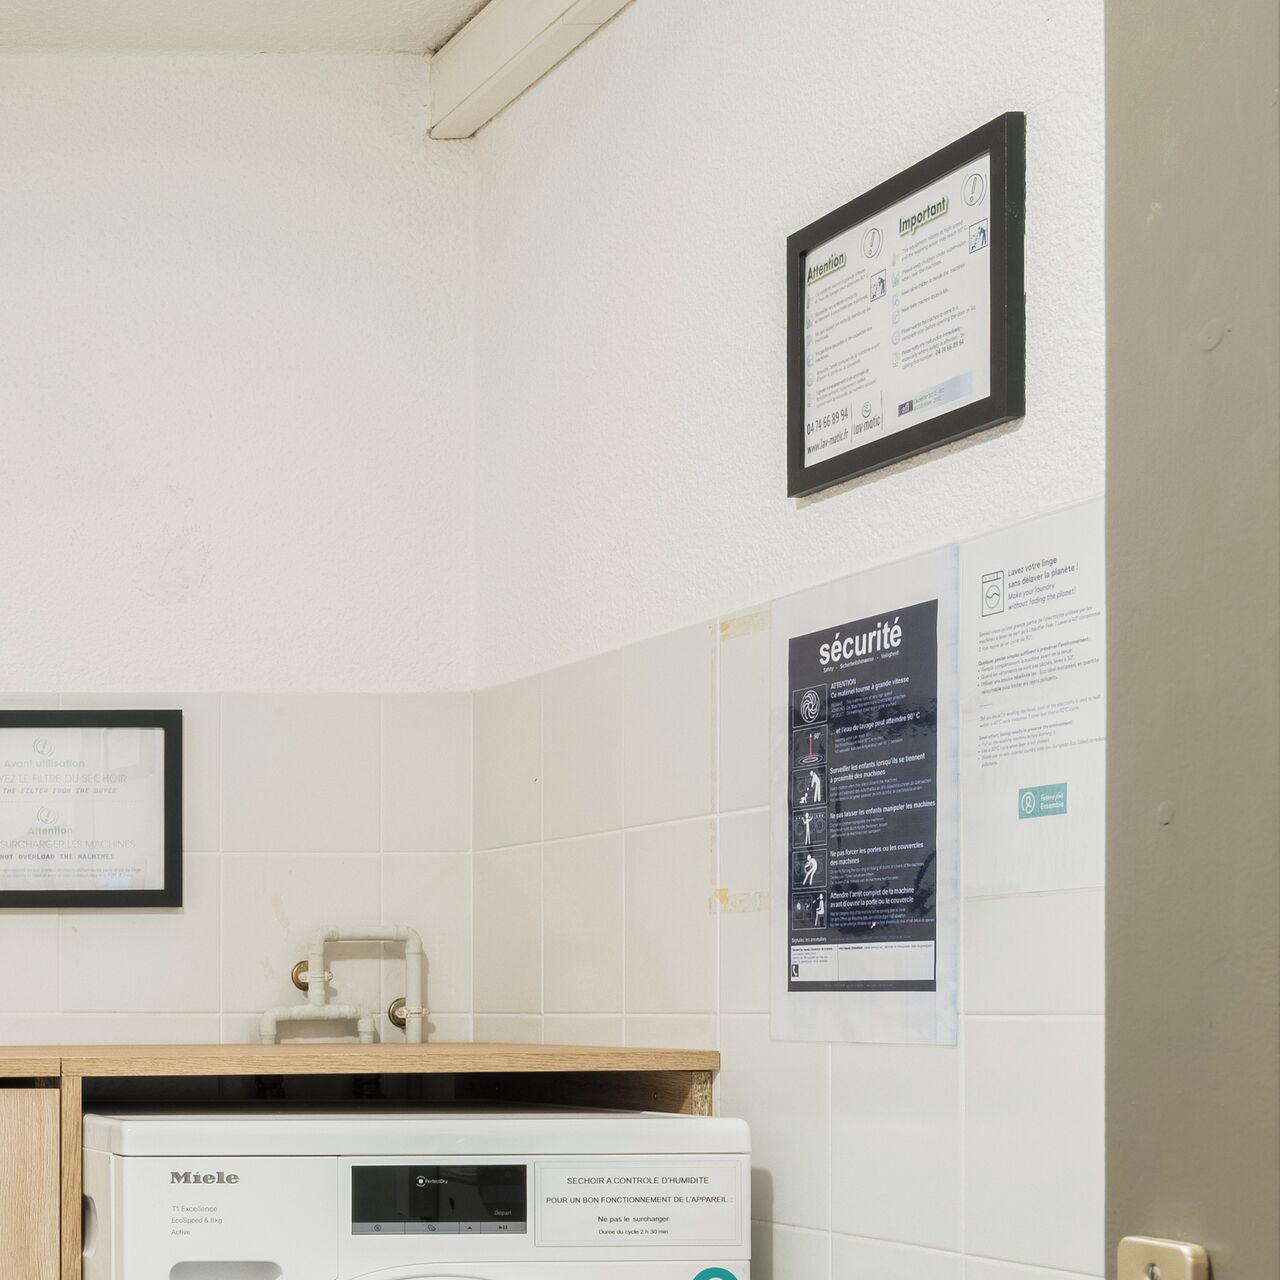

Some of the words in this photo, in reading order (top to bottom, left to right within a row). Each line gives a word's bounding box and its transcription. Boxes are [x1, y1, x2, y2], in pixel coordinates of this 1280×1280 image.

[899, 198, 946, 233] Important
[807, 253, 844, 282] Attention
[807, 422, 814, 435] 04
[815, 420, 822, 432] 74
[823, 416, 831, 430] 66
[832, 413, 839, 426] 89
[841, 408, 848, 421] 94
[1008, 567, 1023, 576] Lavez
[1025, 562, 1040, 572] votre
[1042, 557, 1057, 568] linge
[1008, 580, 1020, 588] sans
[1022, 574, 1042, 584] délaver
[1008, 592, 1021, 600] Make
[1023, 588, 1035, 596] your
[1035, 584, 1055, 593] laundry
[1008, 600, 1028, 610] without
[1029, 595, 1045, 605] fading
[1047, 592, 1055, 600] the
[819, 616, 902, 665] sécurité
[831, 678, 856, 690] ATTENTION
[856, 686, 870, 694] tourne
[876, 680, 891, 691] grande
[892, 677, 909, 687] vitesse
[3, 760, 33, 768] Avant
[36, 760, 85, 768] utilisation
[19, 775, 29, 783] LE
[32, 775, 60, 783] FILTRE
[64, 775, 78, 783] DU
[866, 807, 882, 815] enfants
[914, 800, 935, 809] machines
[28, 826, 73, 834] Attention
[0, 840, 64, 849] SURCHARGER
[67, 840, 83, 848] LES
[85, 840, 136, 848] MACHINES
[170, 1171, 240, 1184] Miele
[171, 1217, 203, 1225] EcoSpeed
[633, 1216, 669, 1224] surcharger
